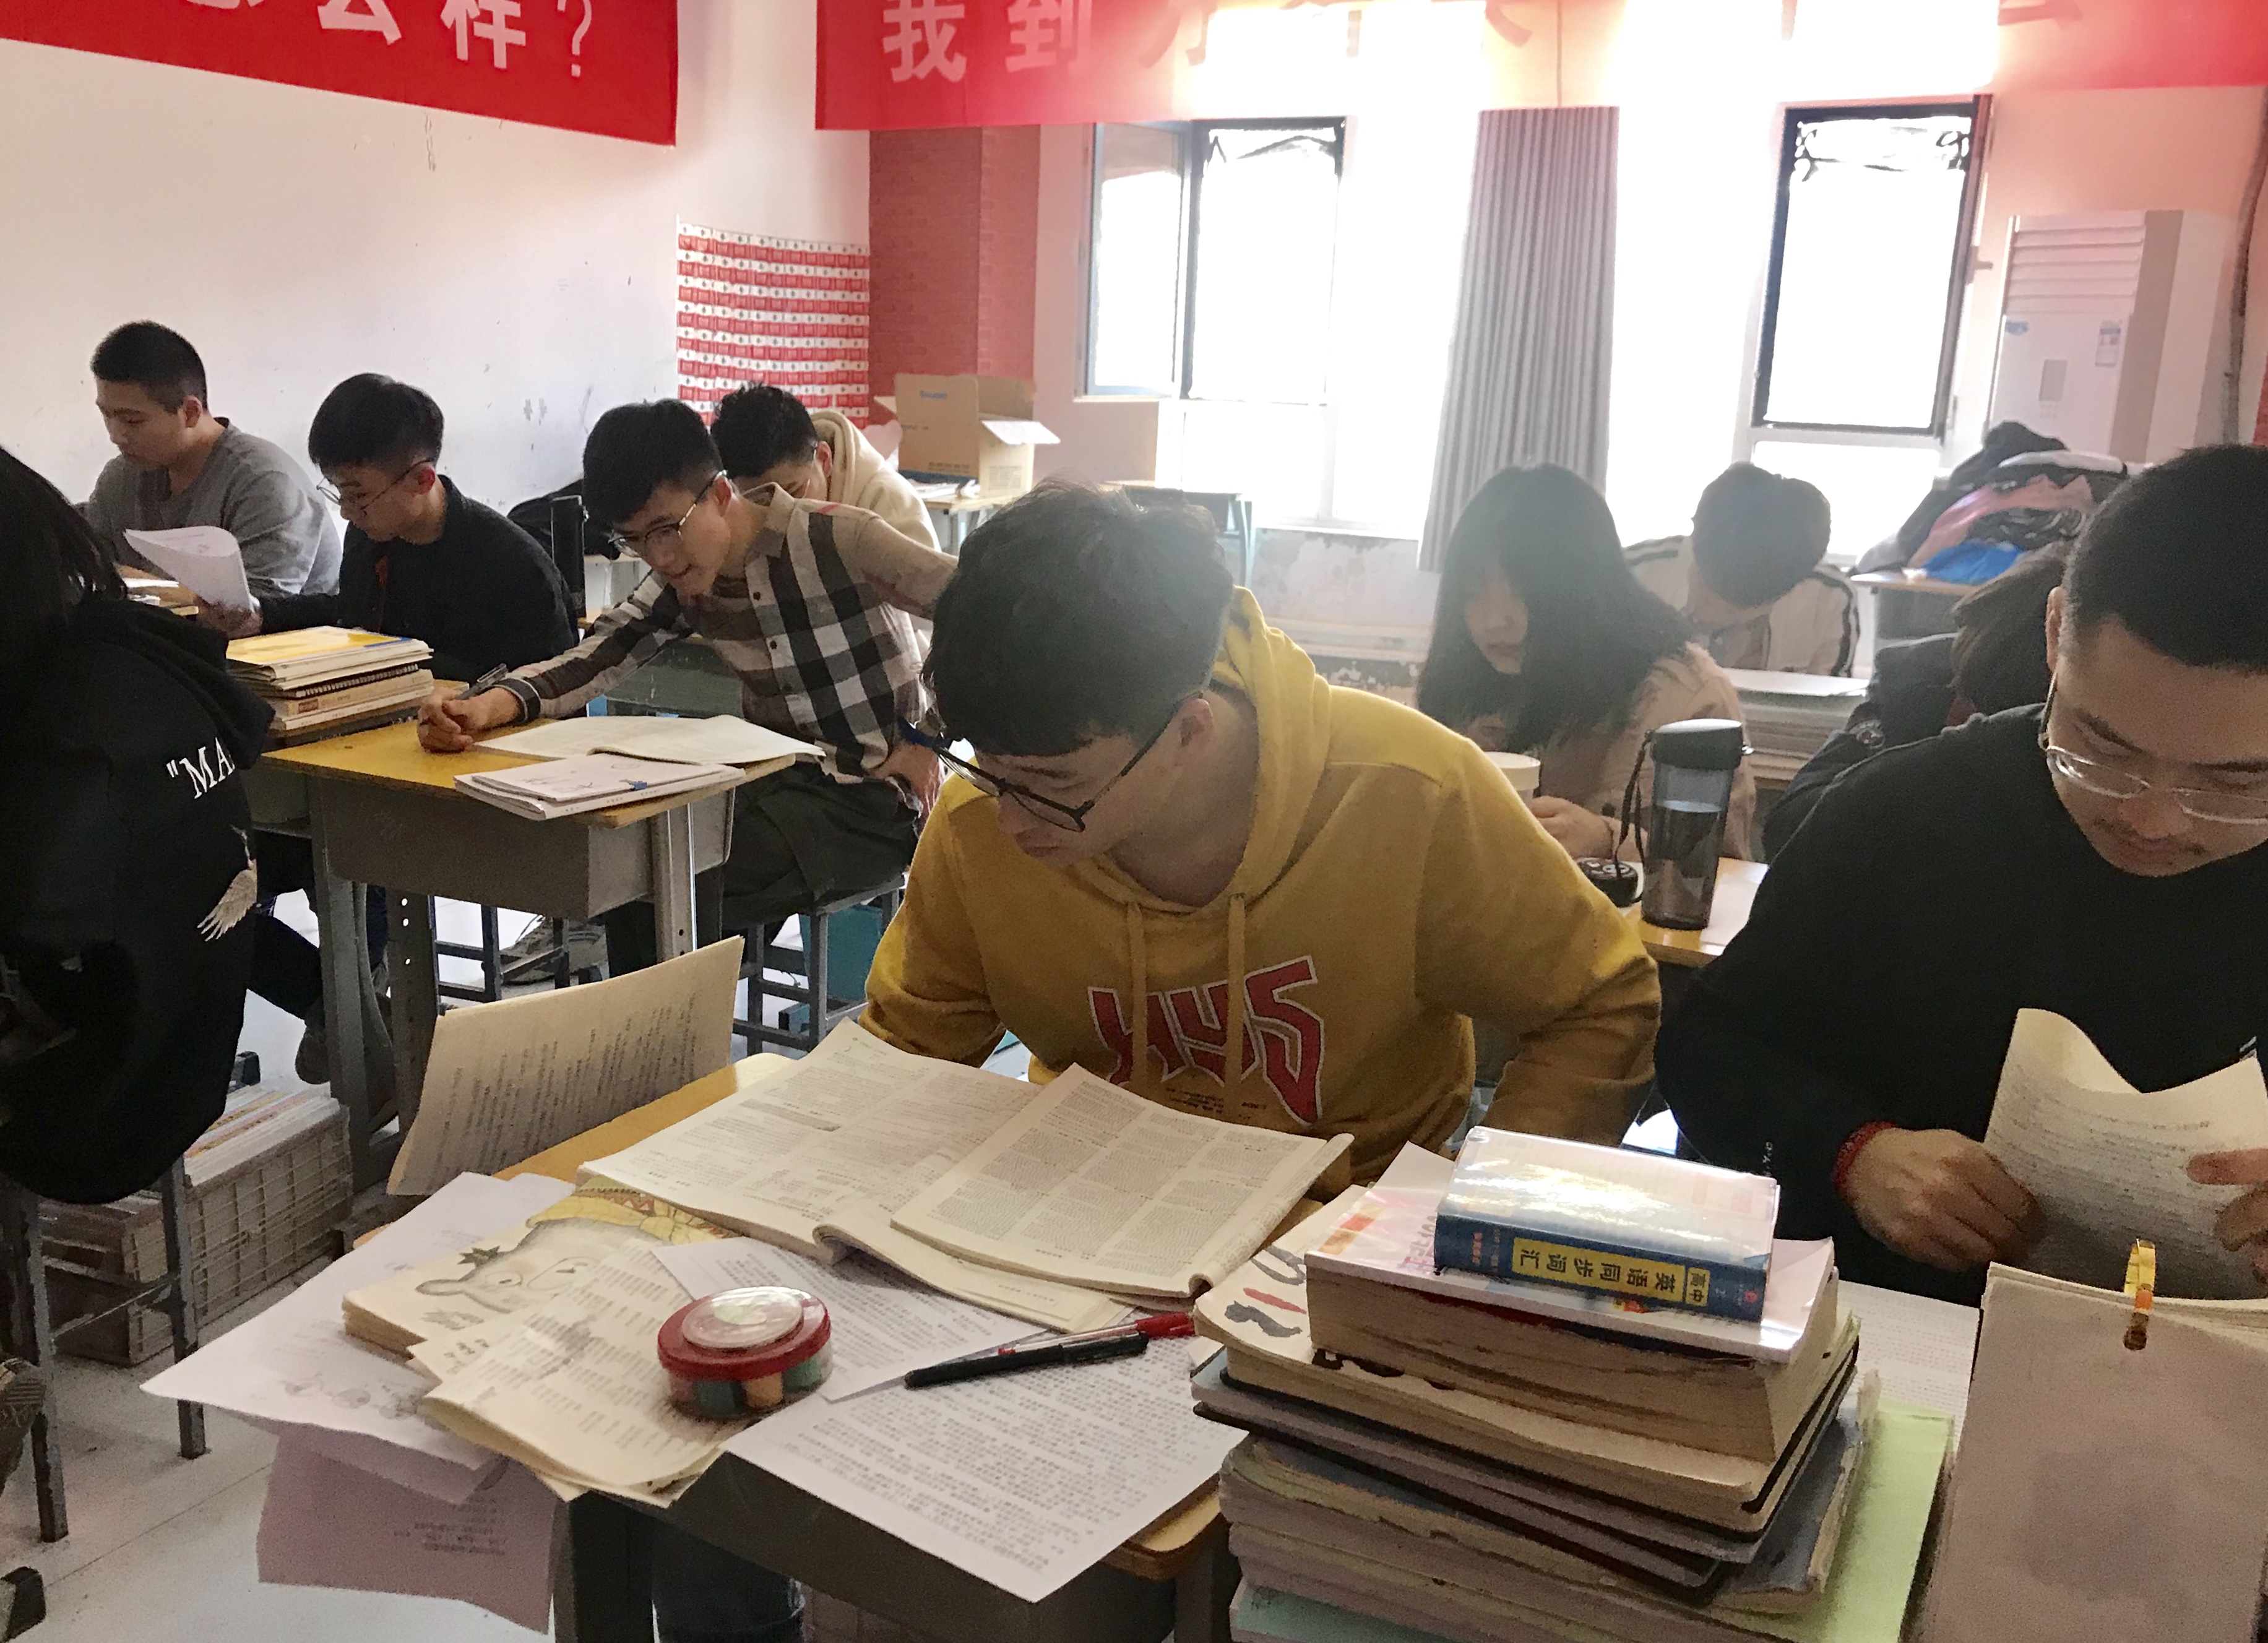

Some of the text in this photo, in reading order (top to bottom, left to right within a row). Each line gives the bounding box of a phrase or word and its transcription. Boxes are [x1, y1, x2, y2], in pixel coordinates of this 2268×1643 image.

[193, 0, 592, 77] 么样？
[1520, 1248, 1676, 1295] 英语同步词汇
[1688, 1272, 1707, 1303] 高中
